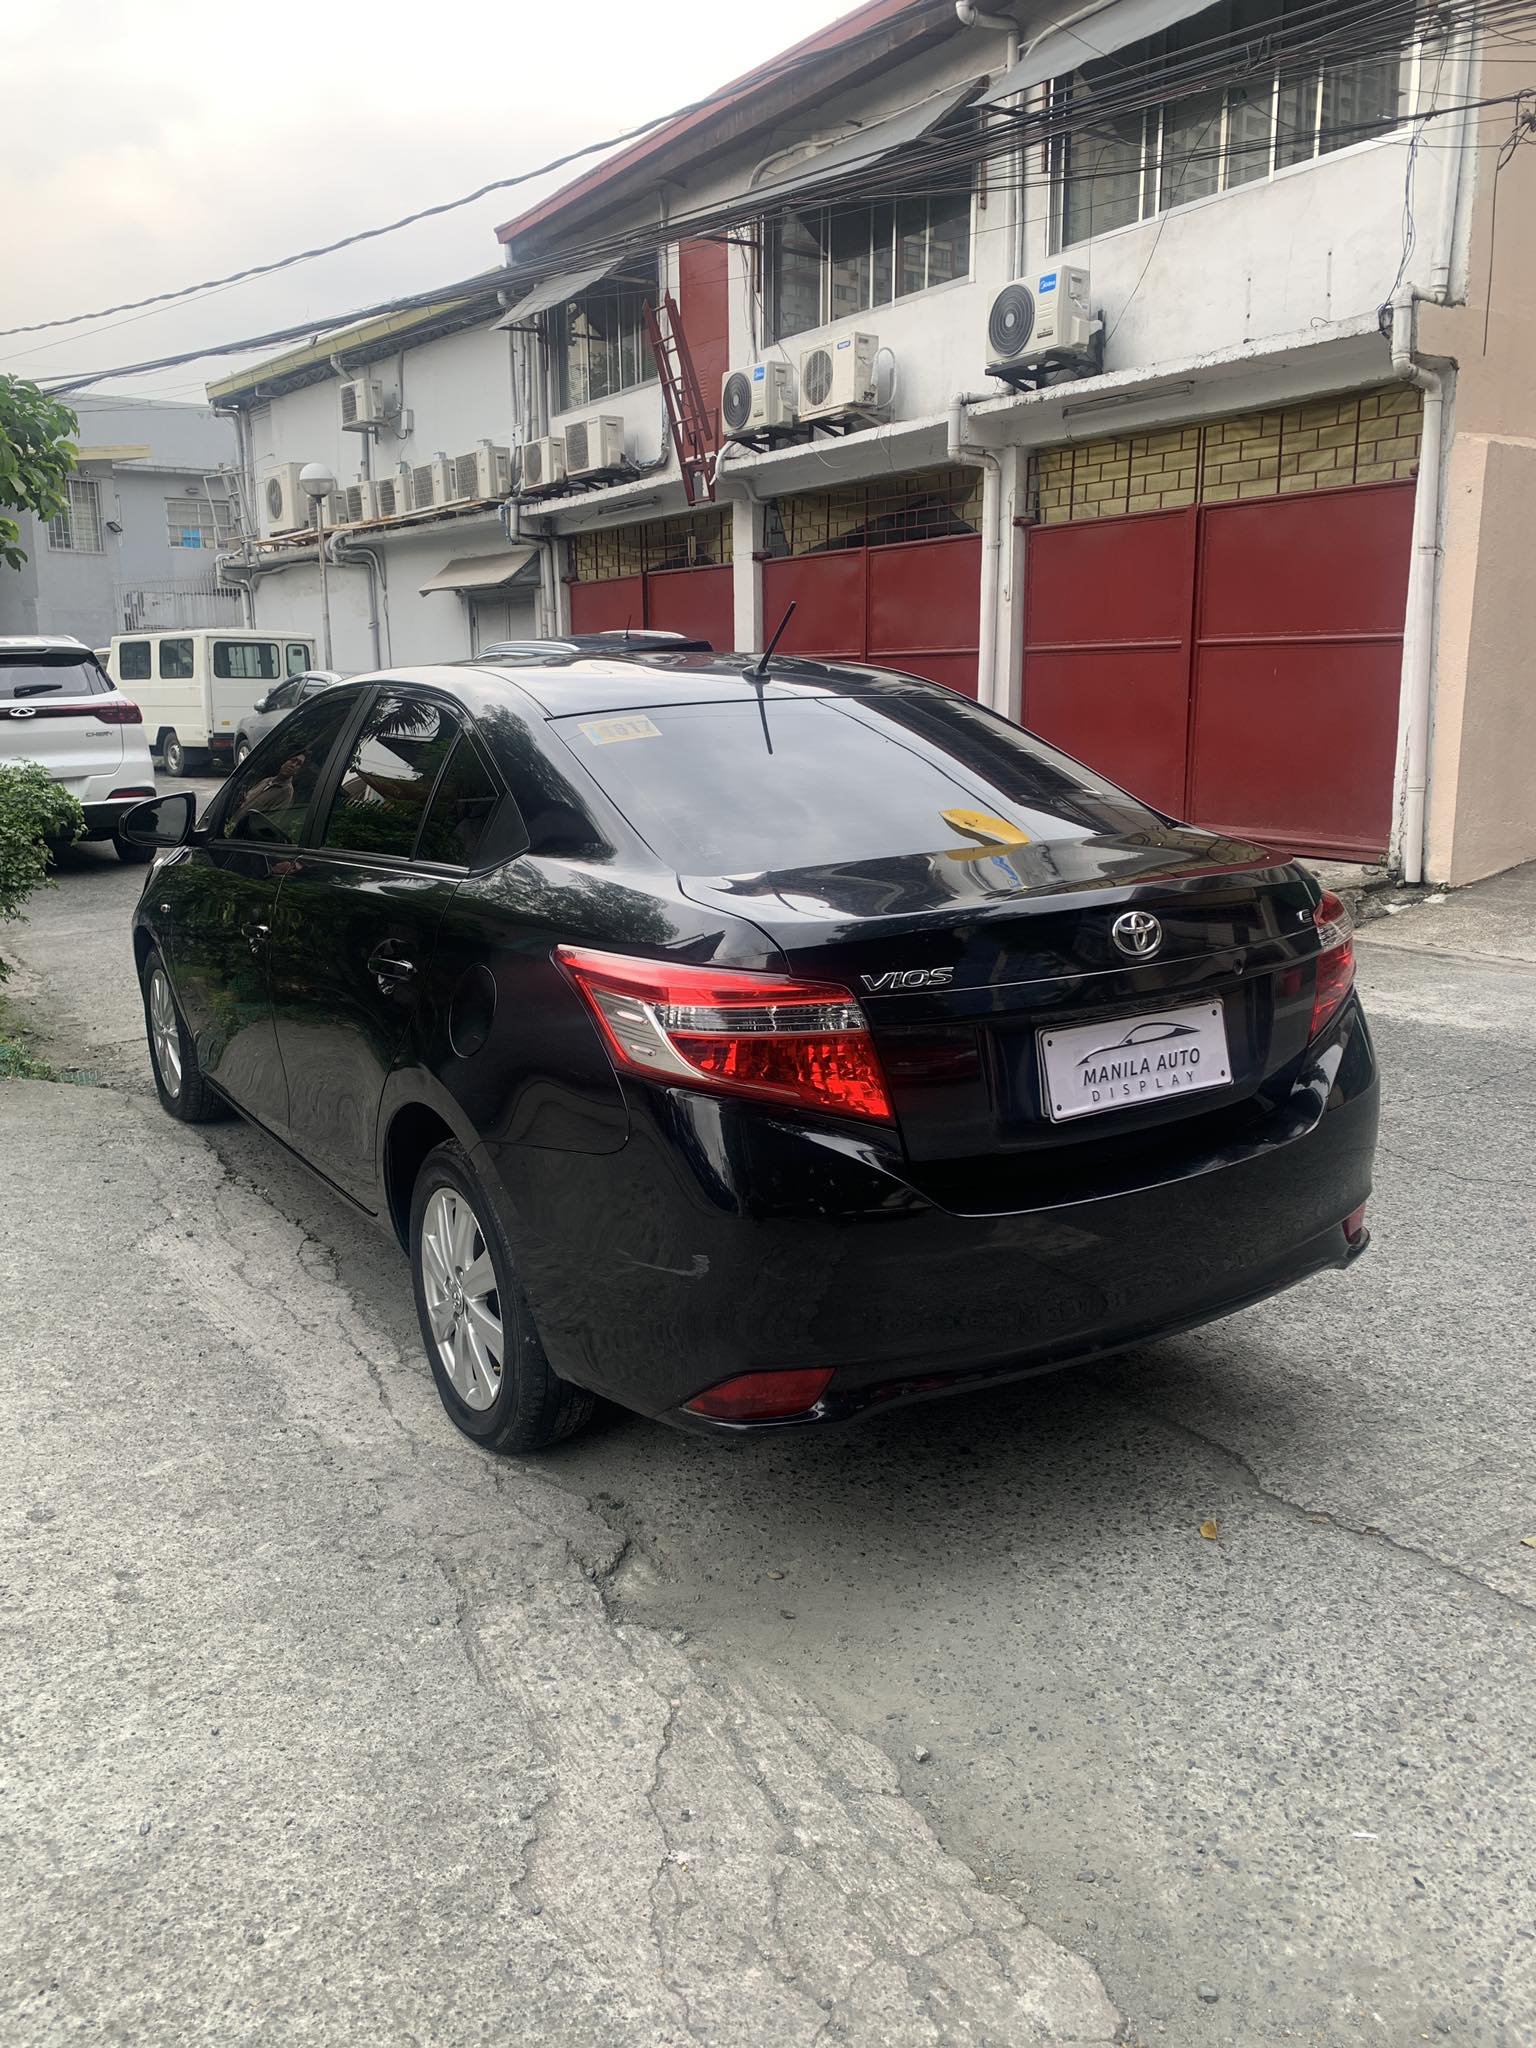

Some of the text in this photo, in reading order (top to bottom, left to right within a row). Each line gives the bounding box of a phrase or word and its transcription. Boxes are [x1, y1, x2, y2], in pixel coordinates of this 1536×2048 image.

[860, 966, 955, 992] VIOS
[1083, 1047, 1200, 1086] MANILA AUTO
[1092, 1070, 1194, 1102] DISPLAY
